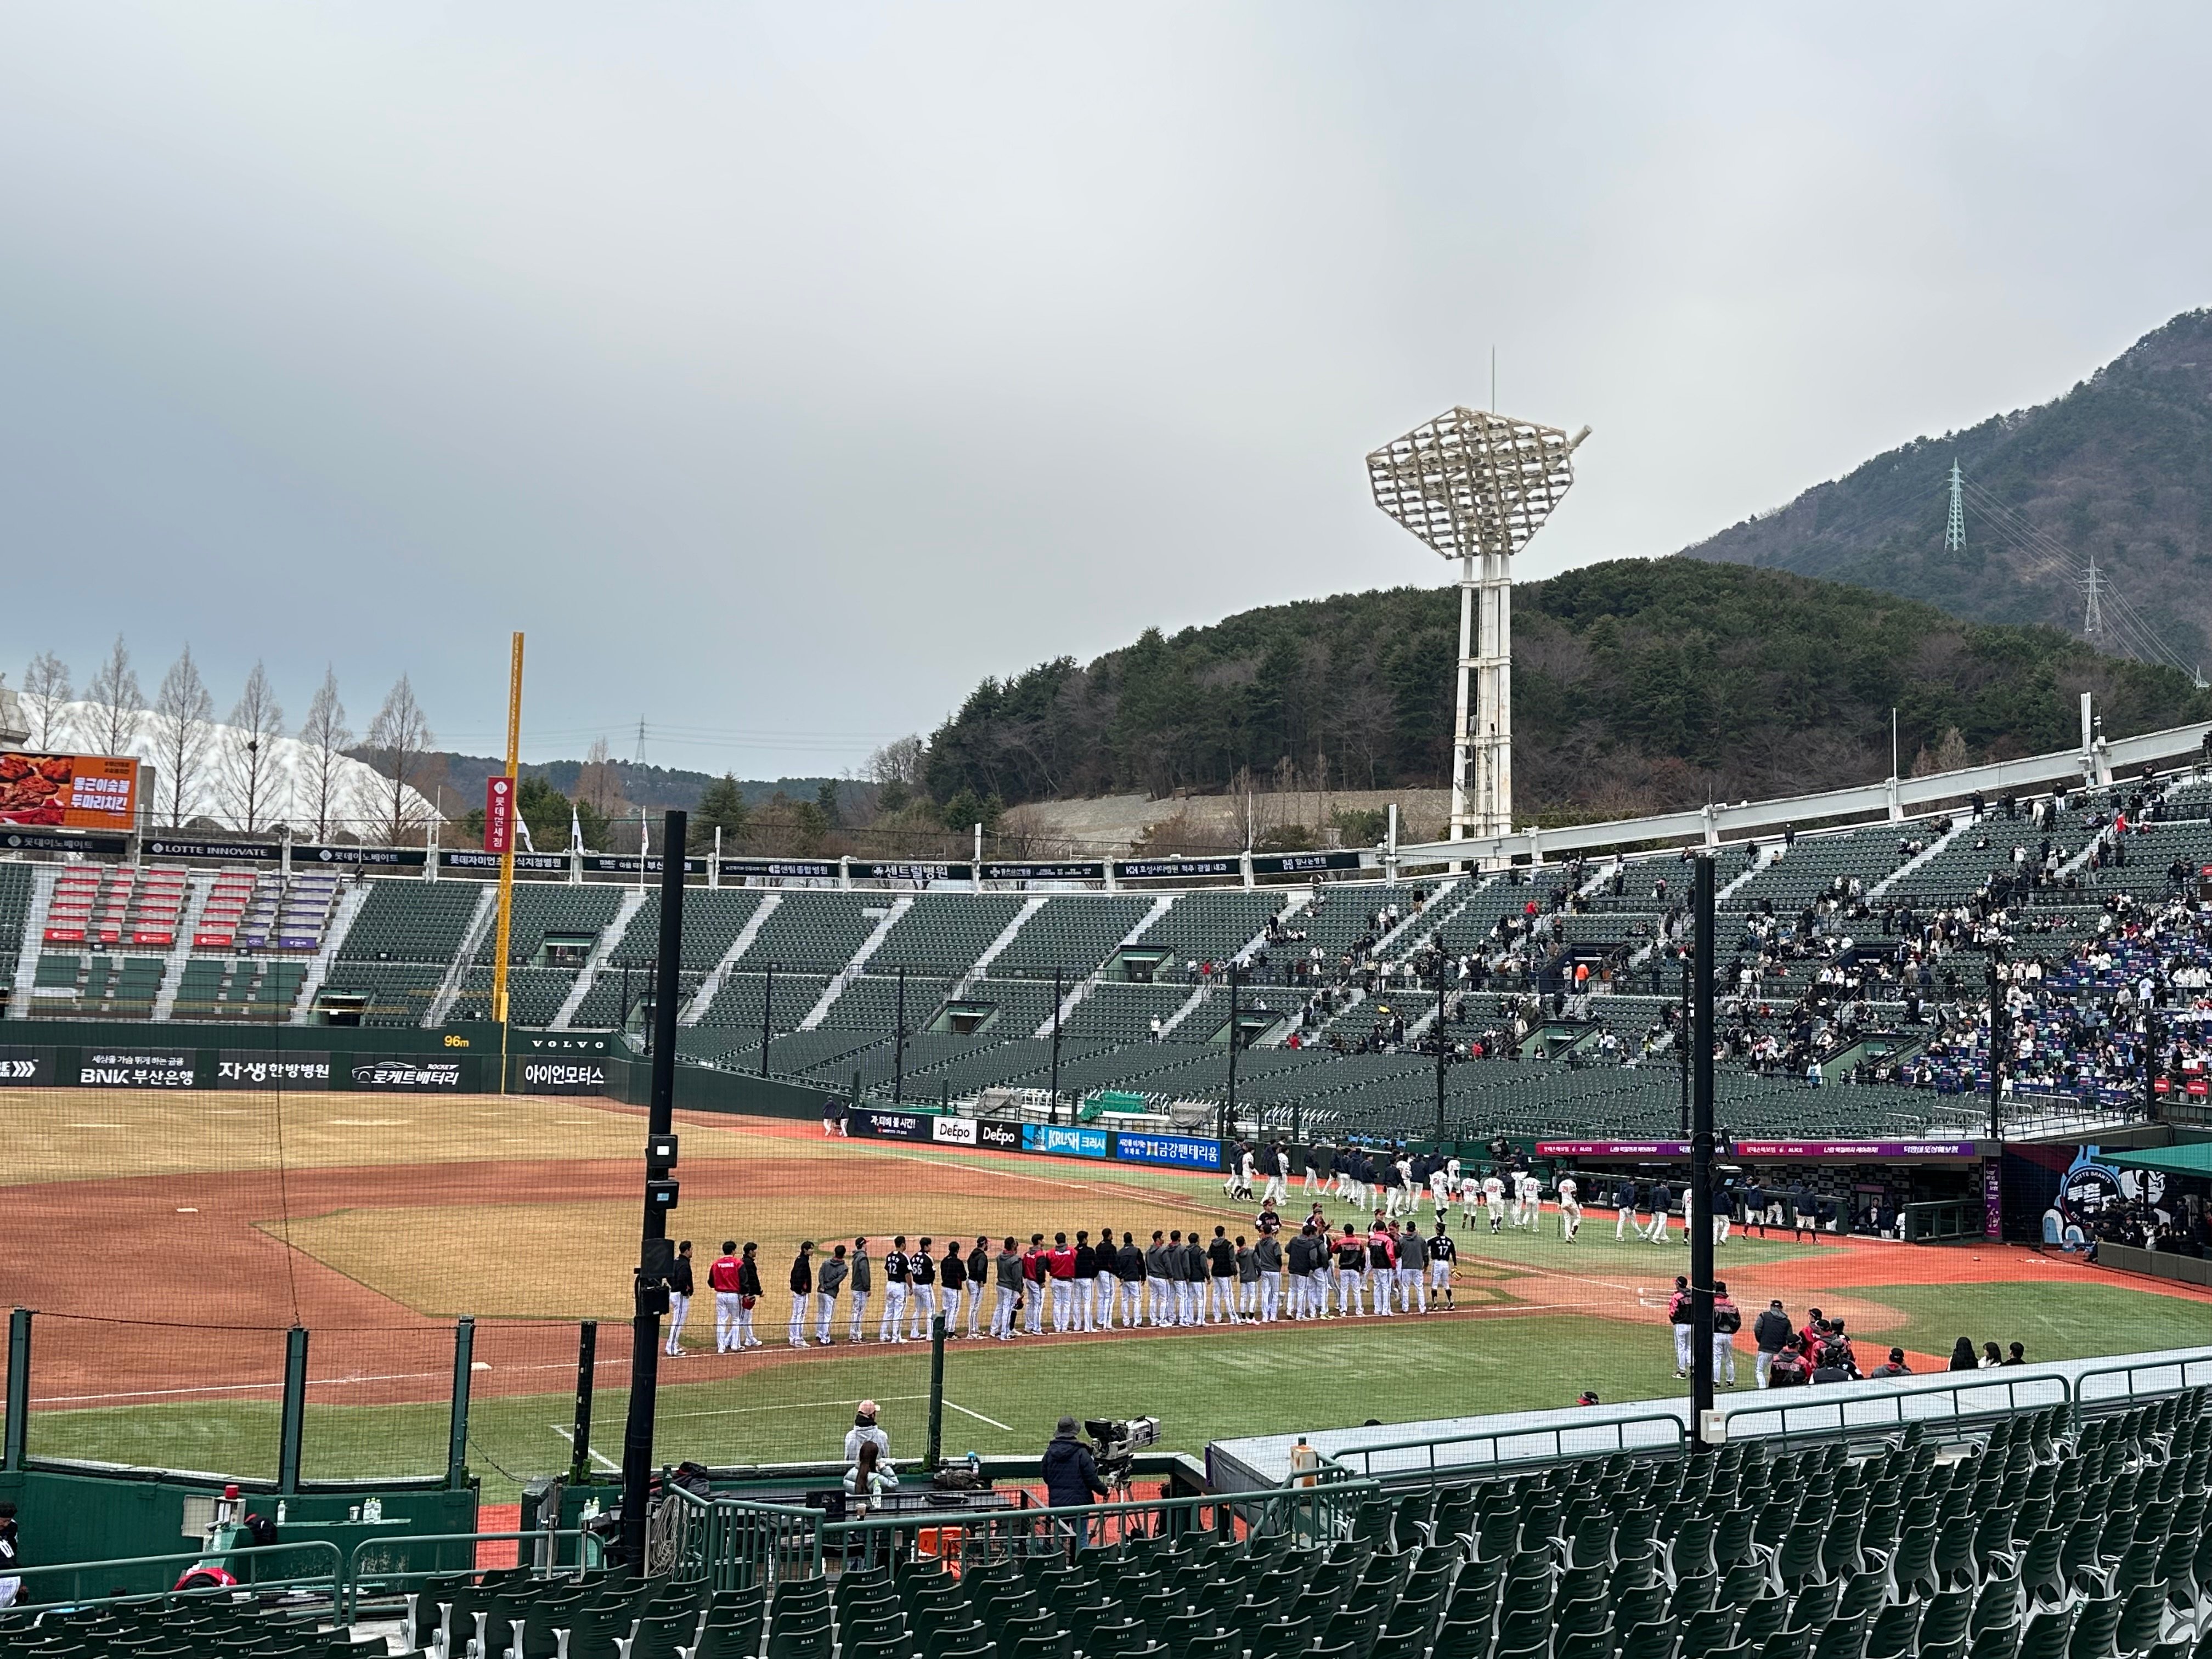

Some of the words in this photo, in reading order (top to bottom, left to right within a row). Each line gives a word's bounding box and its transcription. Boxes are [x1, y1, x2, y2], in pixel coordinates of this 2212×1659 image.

[70, 794, 128, 811] 두마리치킨
[24, 838, 93, 849] 롯데이노베이트
[165, 845, 204, 854] LOTTE
[207, 847, 268, 856] INNOVATE
[884, 865, 949, 879] 센트럴병원
[444, 1035, 469, 1047] 96m
[532, 1040, 604, 1049] VOLVO
[117, 1056, 133, 1064] 가슴
[151, 1057, 167, 1065] 하는
[168, 1057, 184, 1066] 금융
[81, 1069, 129, 1085] BNK
[132, 1070, 194, 1086] 부산은행
[371, 1069, 460, 1085] 로케트배터리
[525, 1064, 605, 1085] 아이언모터스
[940, 1121, 969, 1141] DeÉpo
[983, 1124, 1015, 1146] DeÉpo
[1048, 1130, 1080, 1151] KRUSH
[1081, 1136, 1105, 1150] 크러시
[1158, 1142, 1218, 1162] 금강펜테리움
[2073, 1172, 2089, 1183] LOTTE
[2091, 1172, 2112, 1184] GIANTS
[1438, 1245, 1449, 1256] 17
[888, 1262, 898, 1274] 12
